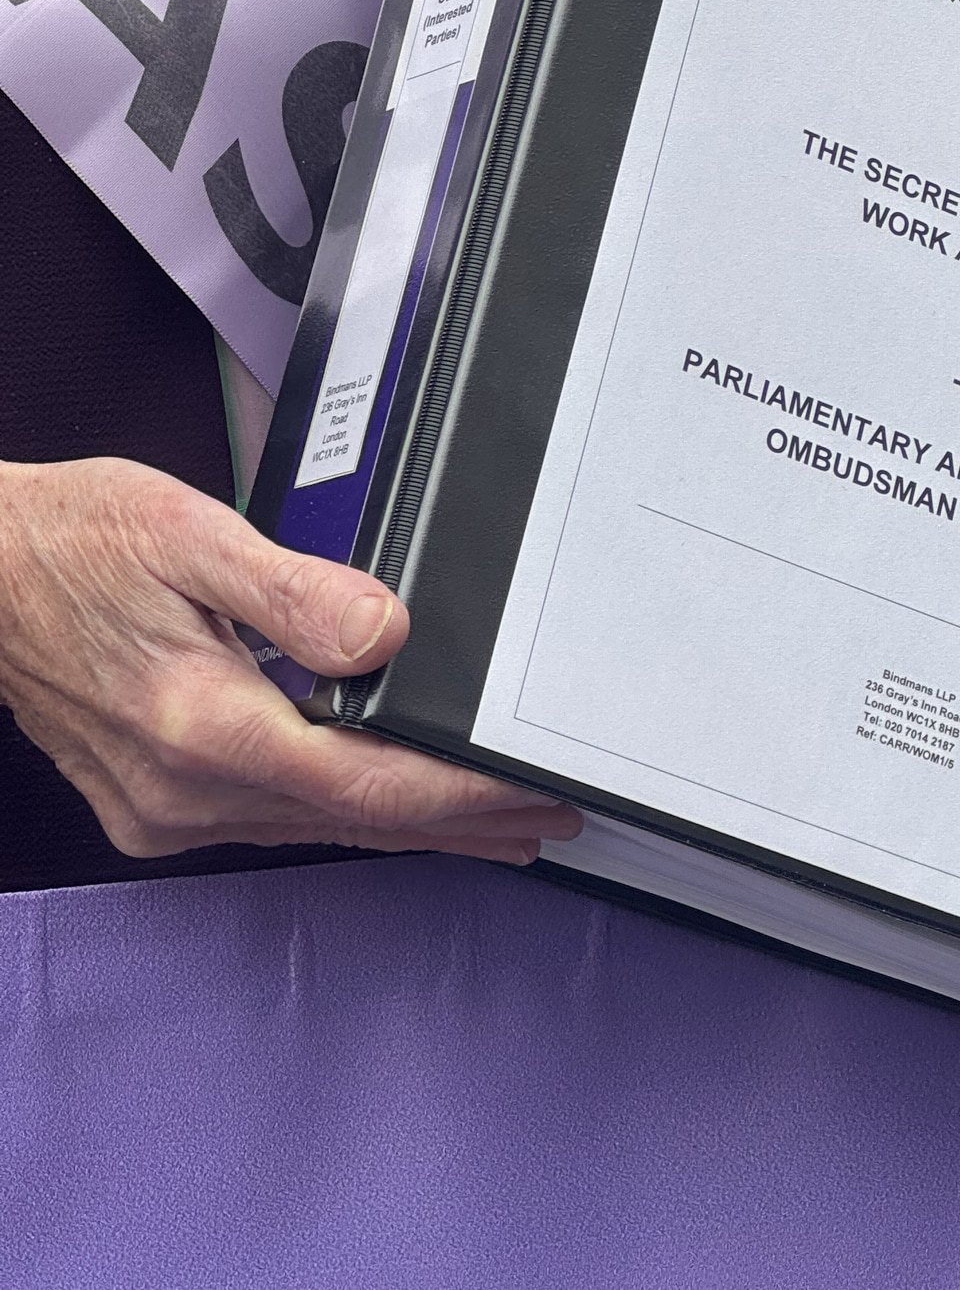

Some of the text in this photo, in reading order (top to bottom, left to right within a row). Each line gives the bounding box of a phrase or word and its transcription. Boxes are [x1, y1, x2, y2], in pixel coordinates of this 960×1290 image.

[423, 0, 474, 32] (Interested
[424, 24, 461, 48] Parties)
[803, 128, 859, 174] THE
[862, 197, 952, 256] WORK
[325, 374, 372, 398] Bindmans LLP
[320, 401, 334, 415] 236
[356, 393, 368, 404] Inn
[329, 411, 349, 427] Road
[682, 348, 933, 465] PARLIAMENTARY
[322, 430, 347, 445] London
[766, 428, 958, 522] OMBUDSMAN
[866, 680, 883, 693] 236
[921, 700, 937, 713] Inn
[883, 669, 956, 702] Bindmans LLP
[864, 711, 955, 752] Tel: 020 7014 2187
[865, 696, 959, 738] London WC1X 8HB
[856, 726, 954, 769] Ref: CARR/WOM1/5
